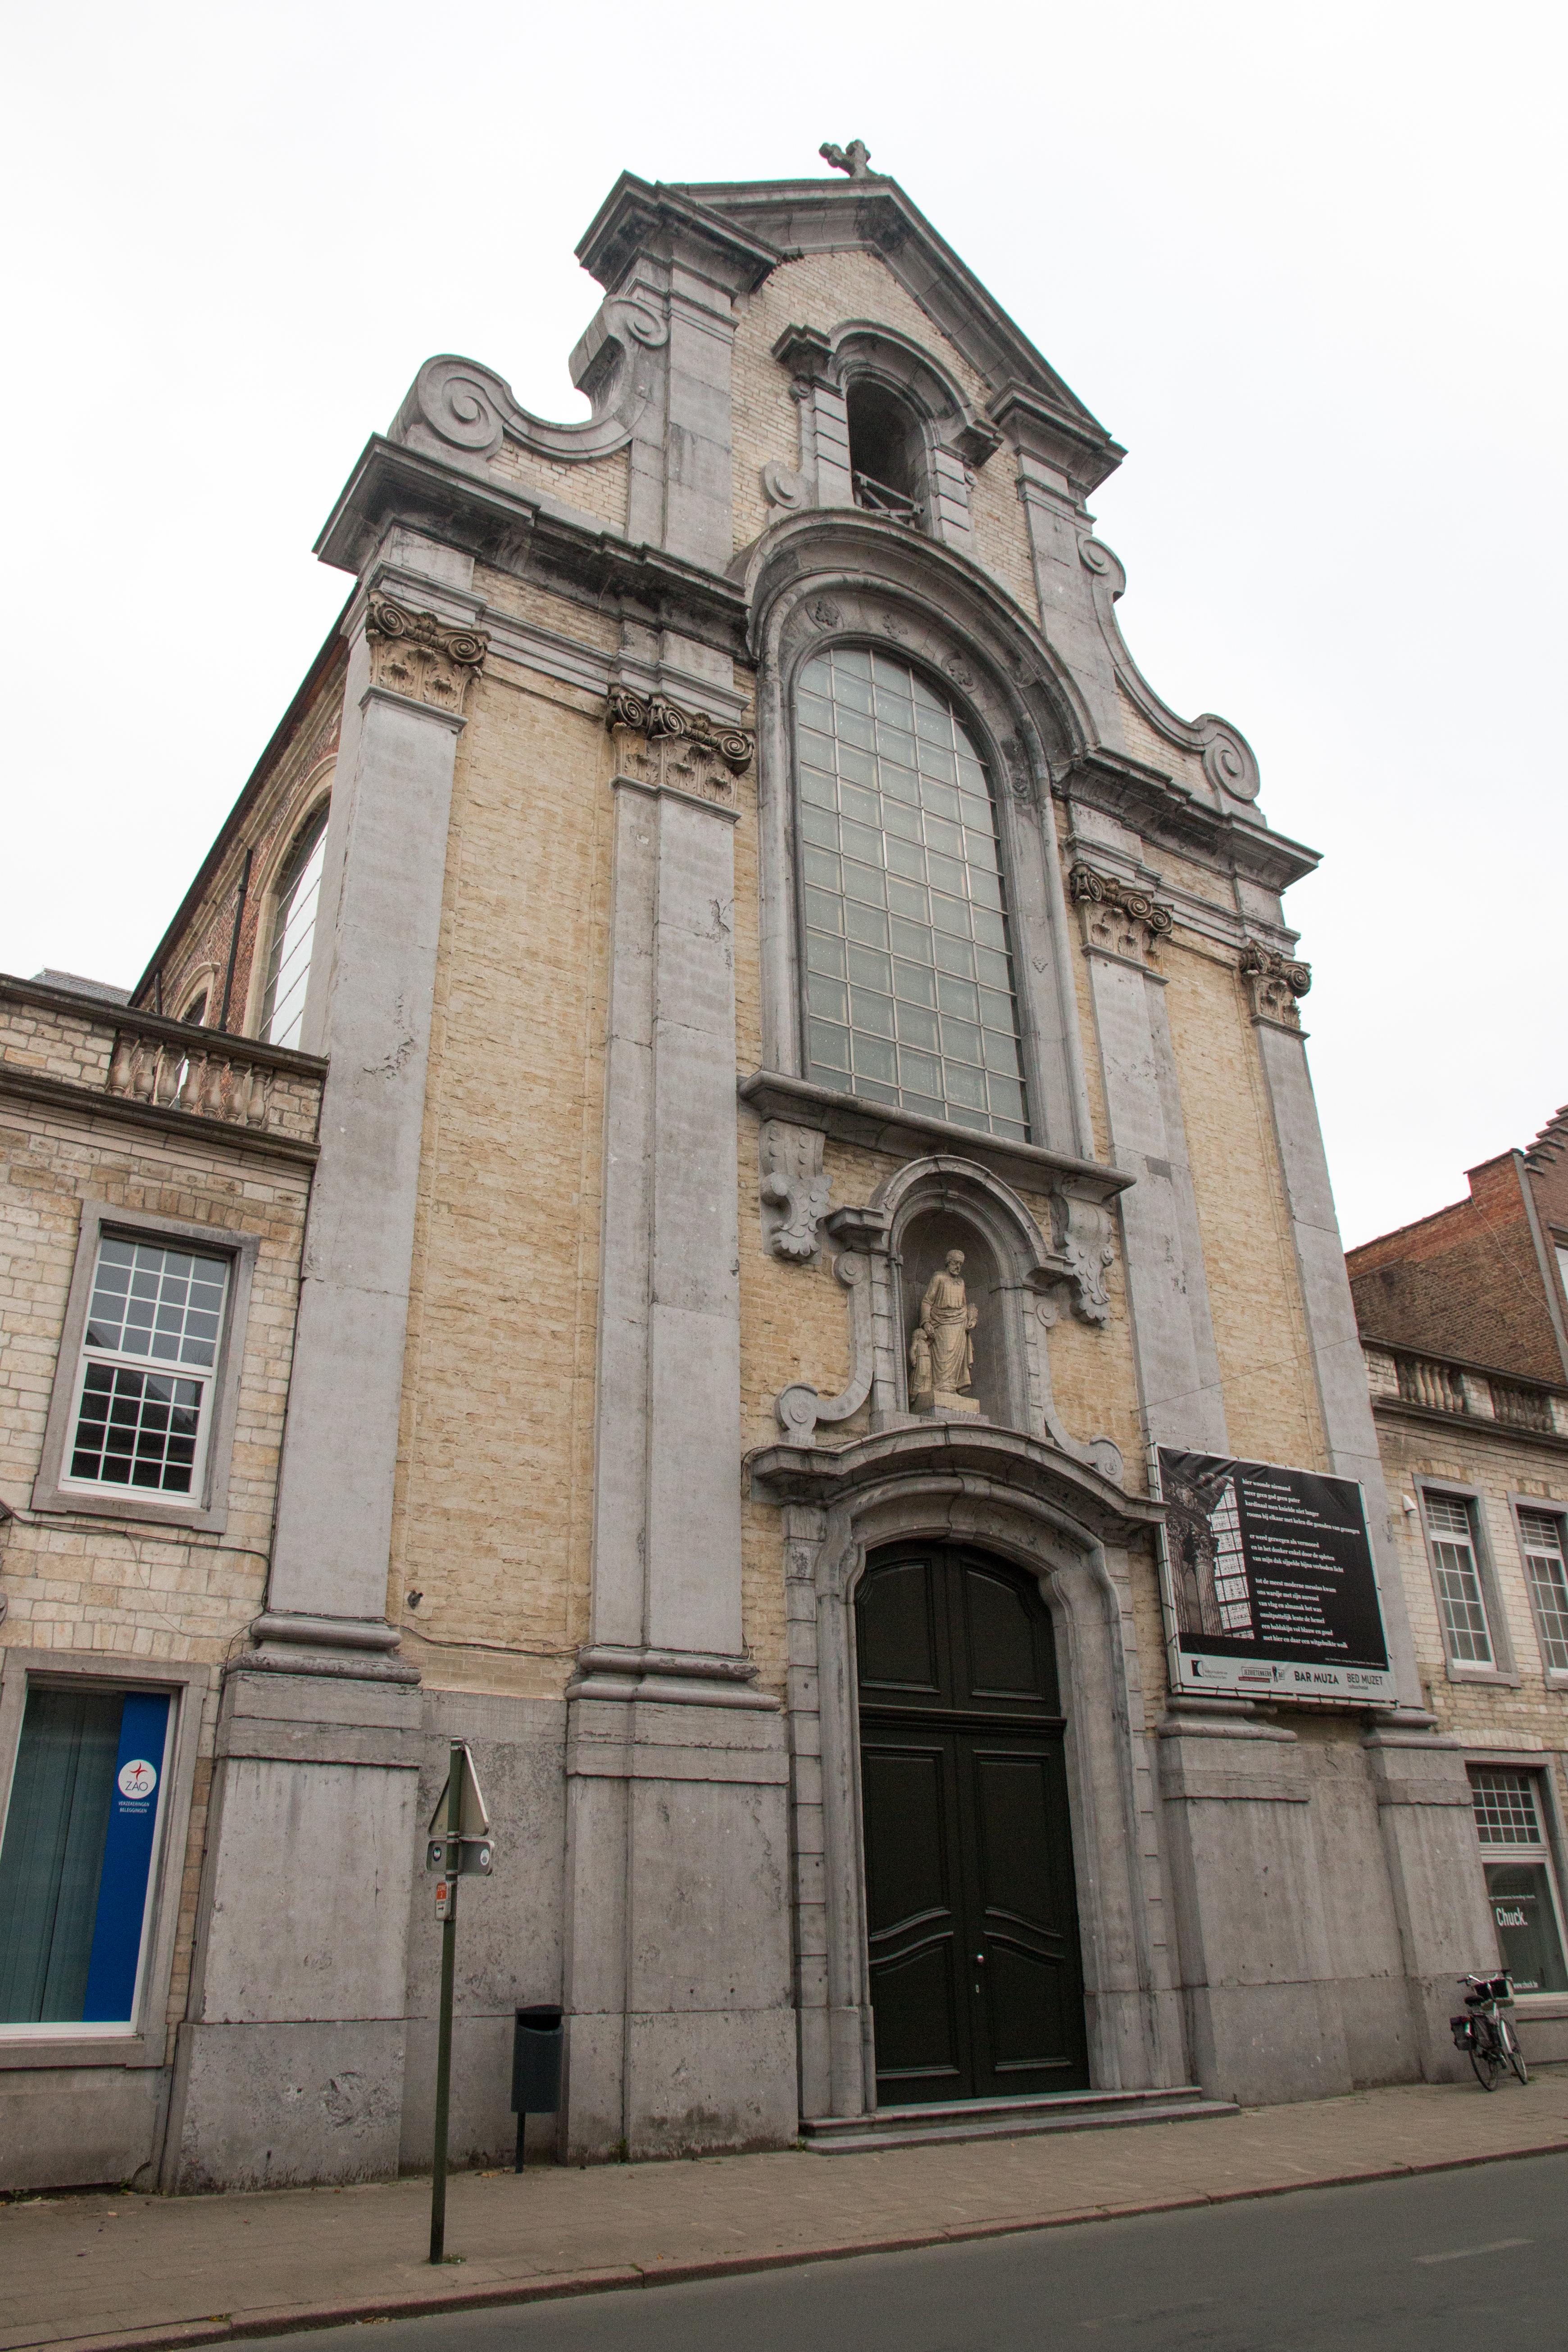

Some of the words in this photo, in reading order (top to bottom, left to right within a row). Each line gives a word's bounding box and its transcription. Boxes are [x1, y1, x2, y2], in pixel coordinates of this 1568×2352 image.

[1271, 1483, 1291, 1491] niemand
[1245, 1500, 1268, 1508] kardinaal
[1305, 1509, 1319, 1517] langer
[1268, 1601, 1278, 1609] vlag
[1270, 1623, 1293, 1632] baldakijn
[1294, 1671, 1312, 1682] BAR
[1314, 1672, 1339, 1684] MUZA
[1347, 1673, 1359, 1683] BED
[1361, 1674, 1383, 1685] MUZET
[125, 1781, 148, 1791] ZAO
[1496, 1907, 1528, 1926] Chuck.
